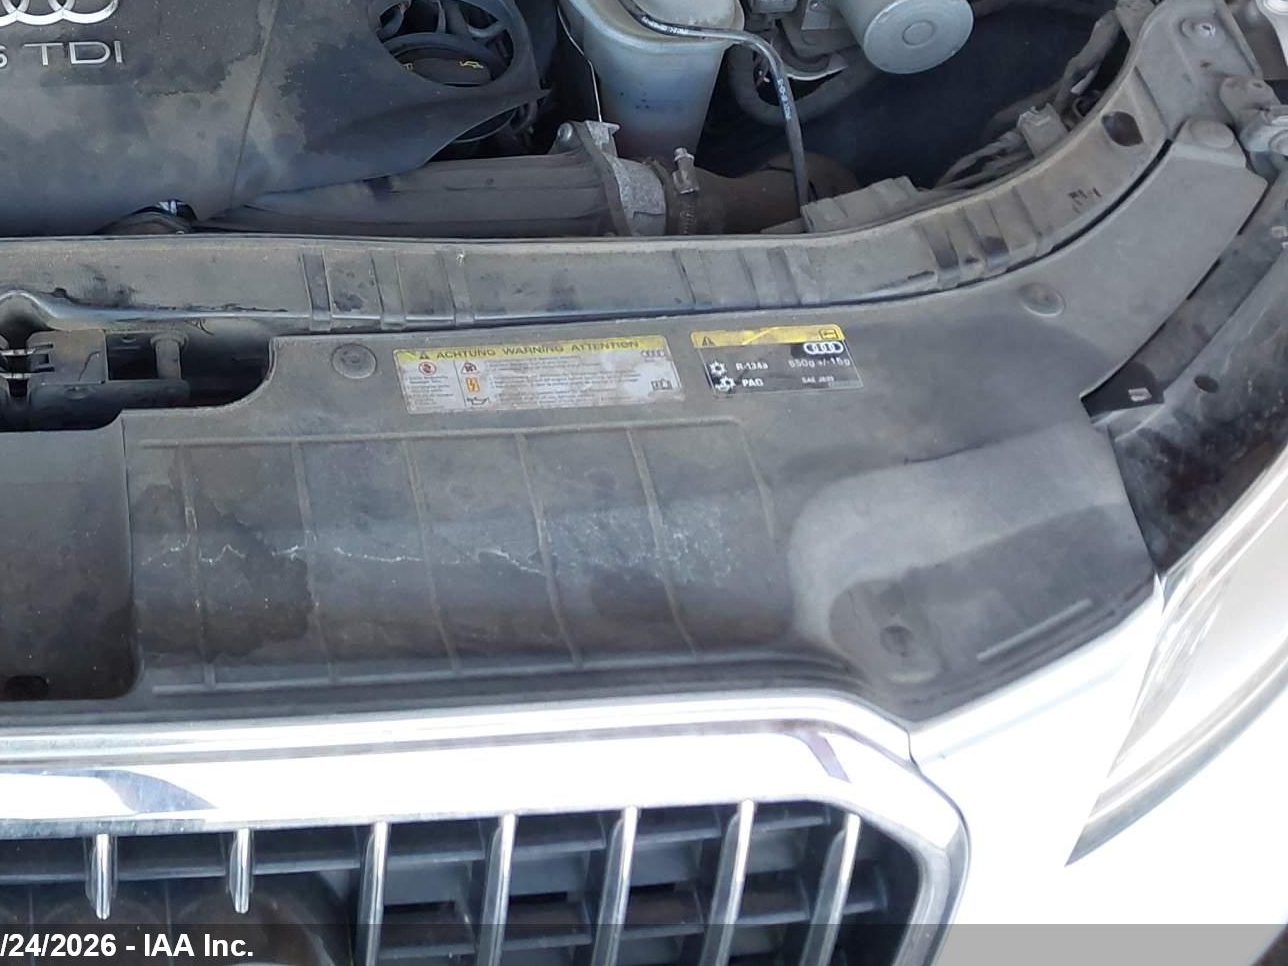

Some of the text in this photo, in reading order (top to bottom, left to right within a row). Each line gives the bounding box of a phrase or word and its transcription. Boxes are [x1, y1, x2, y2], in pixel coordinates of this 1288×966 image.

[23, 40, 123, 66] TDI
[436, 340, 639, 360] ACHTUNG WARNING ATTENTION
[735, 362, 769, 371] R-134a
